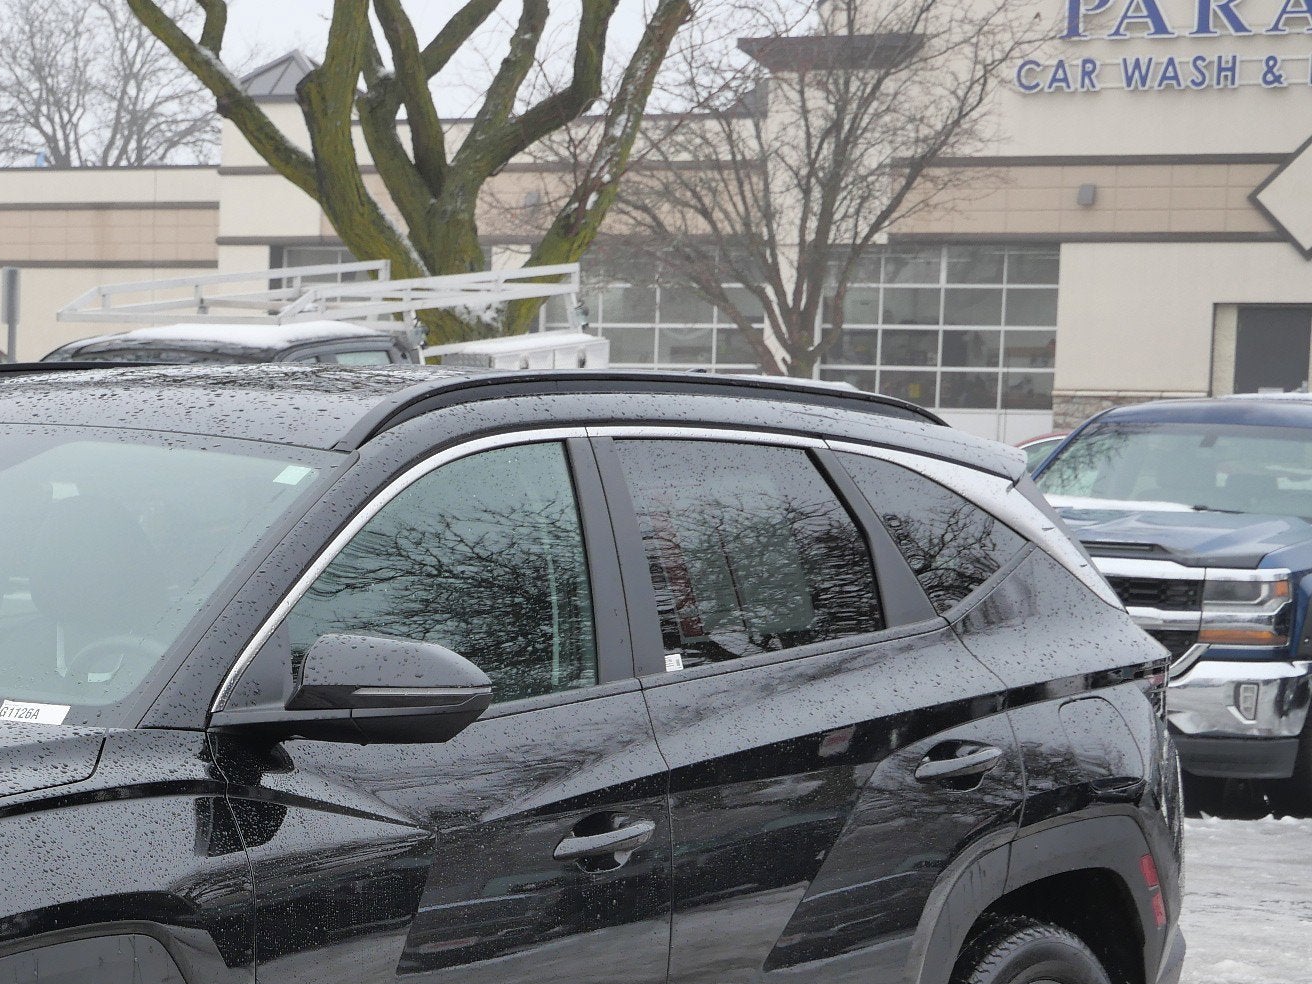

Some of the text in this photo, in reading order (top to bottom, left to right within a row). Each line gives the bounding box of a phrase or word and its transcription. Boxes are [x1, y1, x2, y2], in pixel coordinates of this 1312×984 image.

[1016, 58, 1098, 91] CAR
[1122, 55, 1237, 89] WASH
[1262, 55, 1284, 88] &
[0, 706, 40, 719] G1126A
